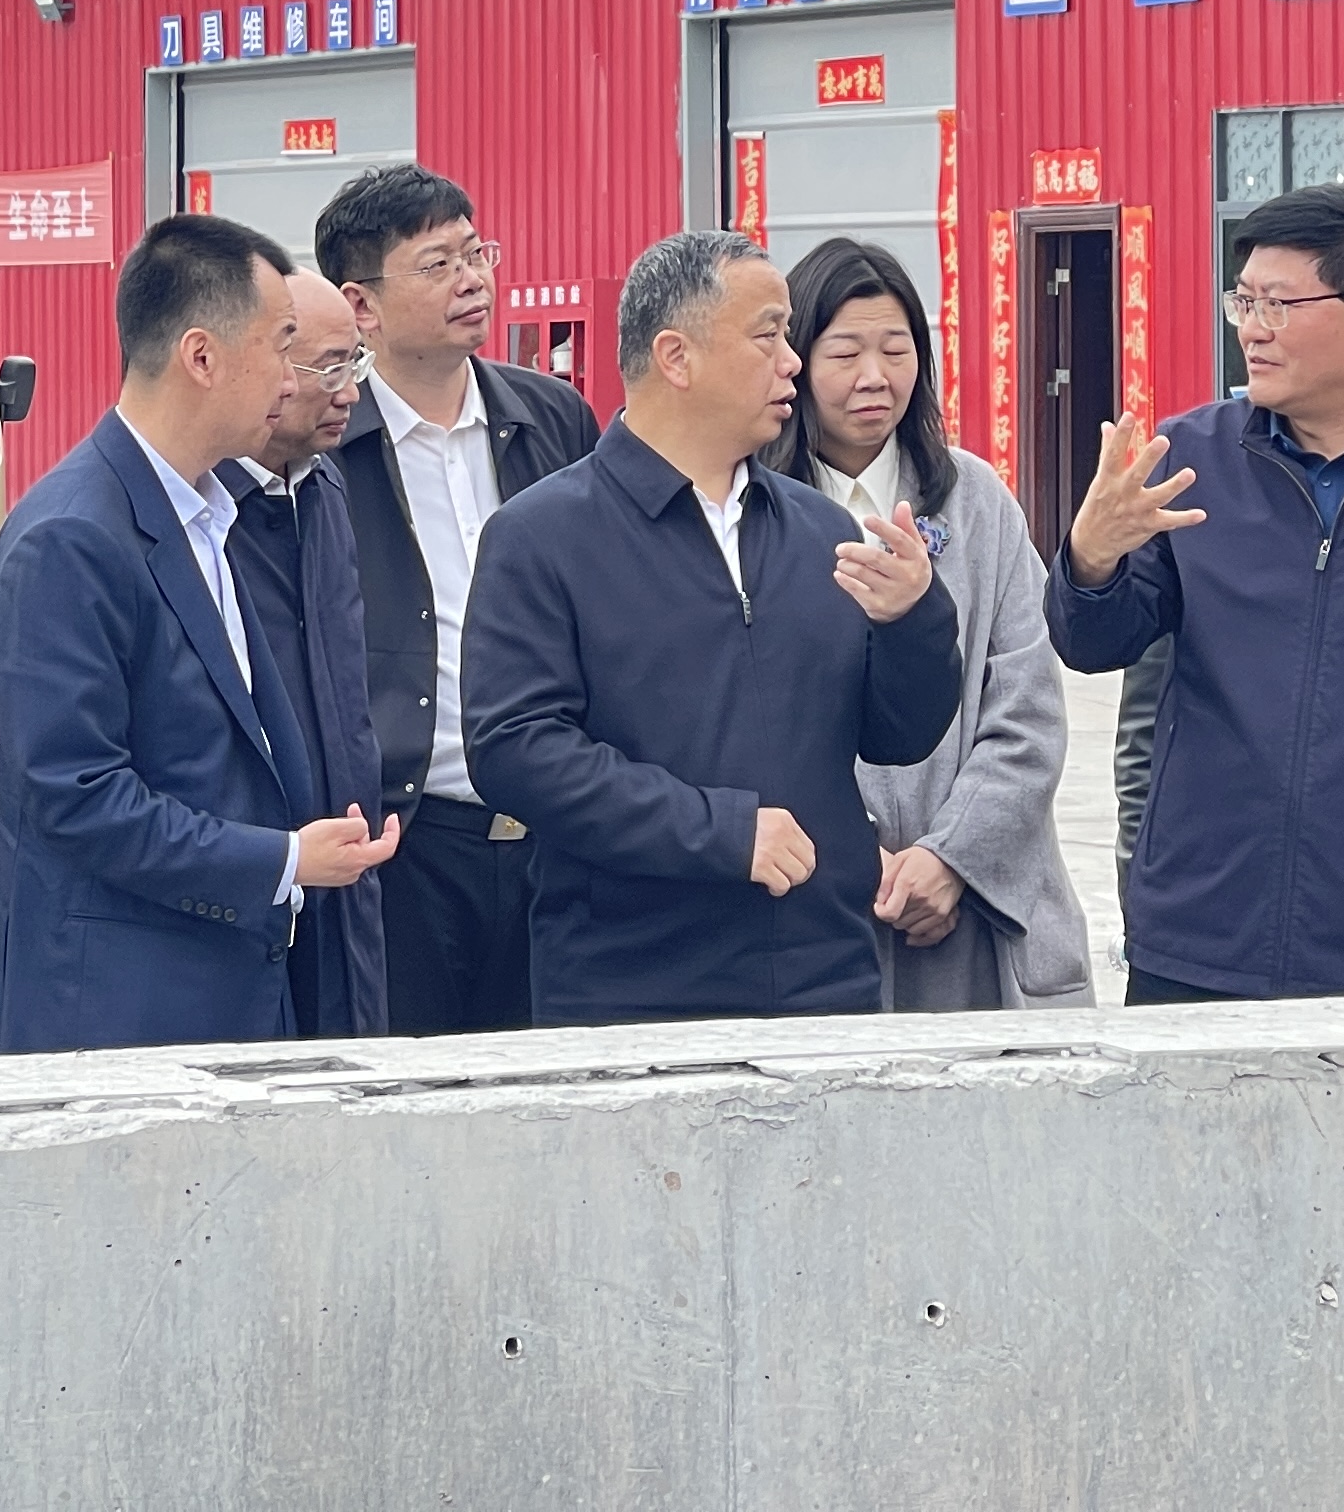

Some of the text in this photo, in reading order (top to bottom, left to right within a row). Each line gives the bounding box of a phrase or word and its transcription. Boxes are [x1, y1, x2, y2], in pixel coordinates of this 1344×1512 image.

[163, 0, 394, 59] 刀具维修车间
[8, 186, 95, 242] 生命至上
